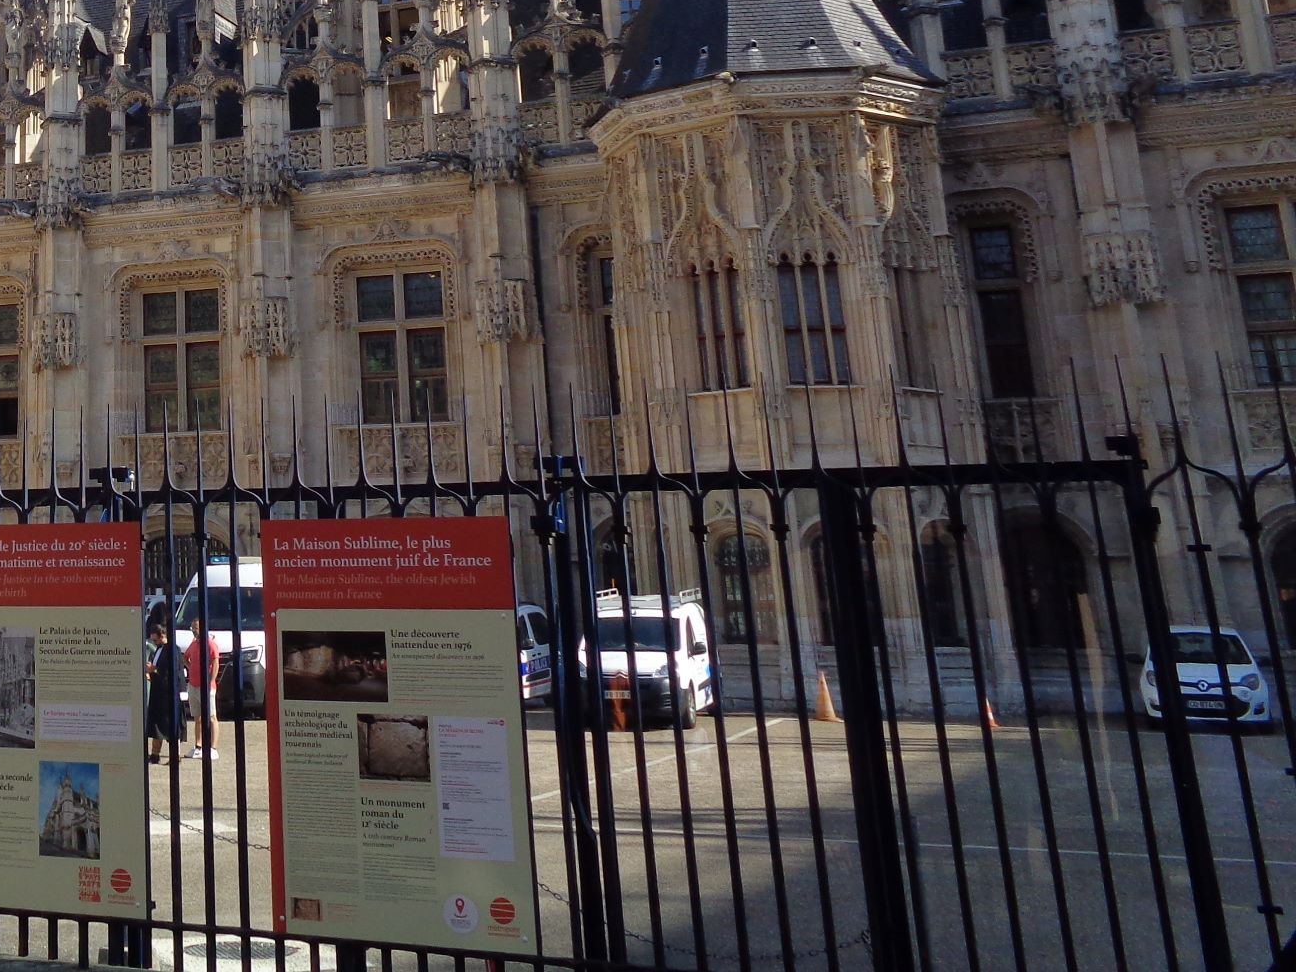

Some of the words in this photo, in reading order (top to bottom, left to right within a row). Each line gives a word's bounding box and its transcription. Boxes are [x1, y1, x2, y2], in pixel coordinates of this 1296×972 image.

[11, 540, 48, 555] Justice
[50, 538, 66, 551] du
[88, 538, 121, 551] siècle
[274, 538, 288, 551] La
[292, 537, 340, 550] Maison
[344, 536, 403, 552] Sublime,
[406, 536, 418, 550] le
[422, 535, 451, 553] plus
[45, 557, 56, 568] et
[59, 555, 126, 568] renaissance
[274, 556, 316, 569] ancien
[320, 557, 392, 569] monument
[395, 553, 421, 570] juif
[424, 554, 439, 568] de
[443, 553, 492, 568] France
[3, 574, 31, 586] Justice
[45, 573, 60, 584] the
[276, 574, 296, 586] The
[298, 574, 336, 586] Maison
[386, 573, 403, 585] the
[405, 573, 437, 585] oldest
[440, 573, 477, 586] Jewish
[275, 590, 331, 600] monument
[333, 589, 344, 600] in
[346, 589, 383, 600] France
[39, 626, 48, 635] Le
[49, 626, 71, 635] Palais
[72, 626, 82, 635] de
[83, 626, 110, 637] Justice,
[390, 629, 411, 639] Une
[412, 628, 460, 639] découverte
[54, 637, 82, 645] victime
[83, 637, 93, 645] de
[94, 637, 101, 645] la
[391, 639, 439, 650] inattendue
[441, 642, 452, 650] en
[454, 640, 472, 652] 1976
[39, 647, 69, 656] Seconde
[69, 647, 96, 656] Guerre
[96, 647, 132, 656] mondiale
[284, 710, 295, 718] Un
[296, 710, 340, 720] témoignage
[284, 720, 337, 731] archéologique
[338, 720, 348, 729] du
[285, 740, 322, 749] rouennais
[5, 772, 33, 782] seconde
[361, 796, 374, 807] Un
[376, 799, 426, 810] monument
[361, 809, 390, 819] roman
[392, 808, 404, 819] du
[373, 819, 400, 830] siècle
